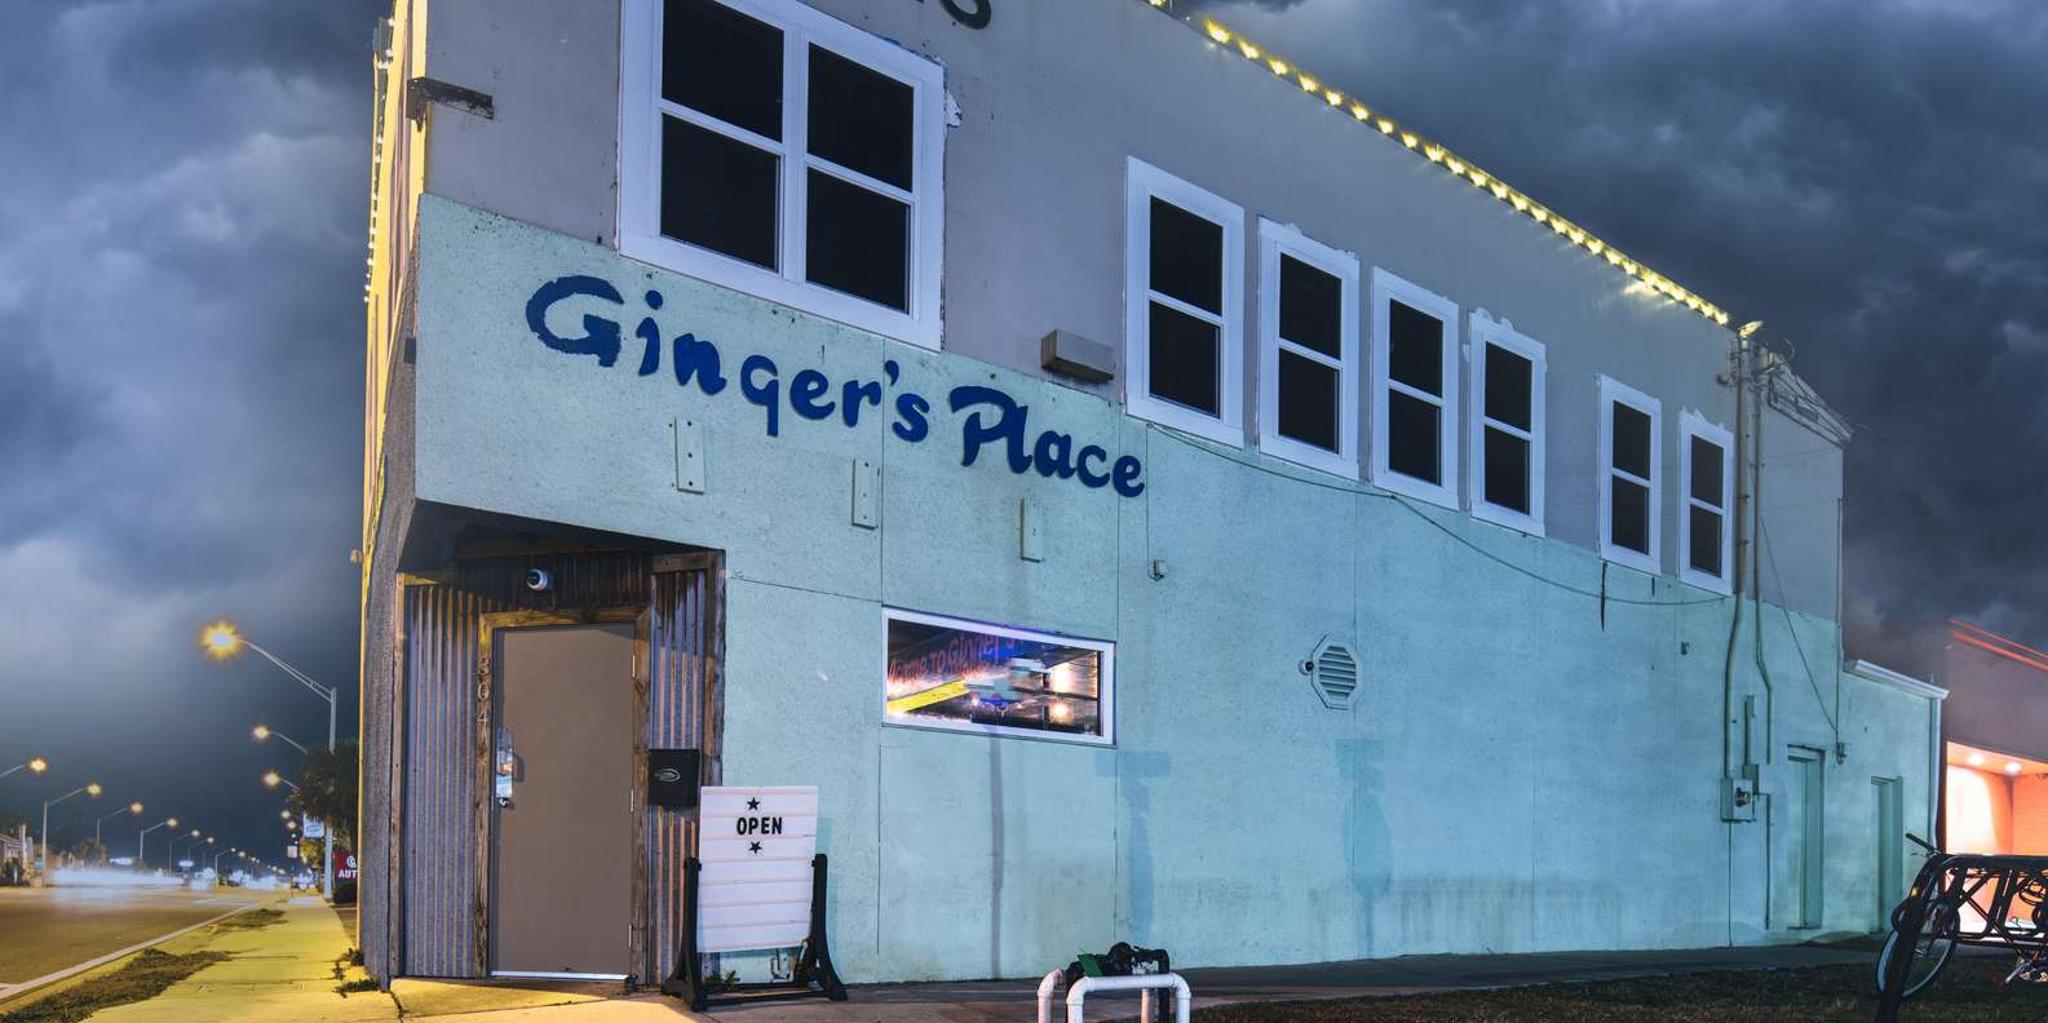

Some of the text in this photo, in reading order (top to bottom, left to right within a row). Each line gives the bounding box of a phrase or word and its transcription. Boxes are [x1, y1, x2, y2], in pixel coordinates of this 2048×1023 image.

[526, 275, 1145, 498] Ginger's Place
[736, 817, 782, 835] OPEN
